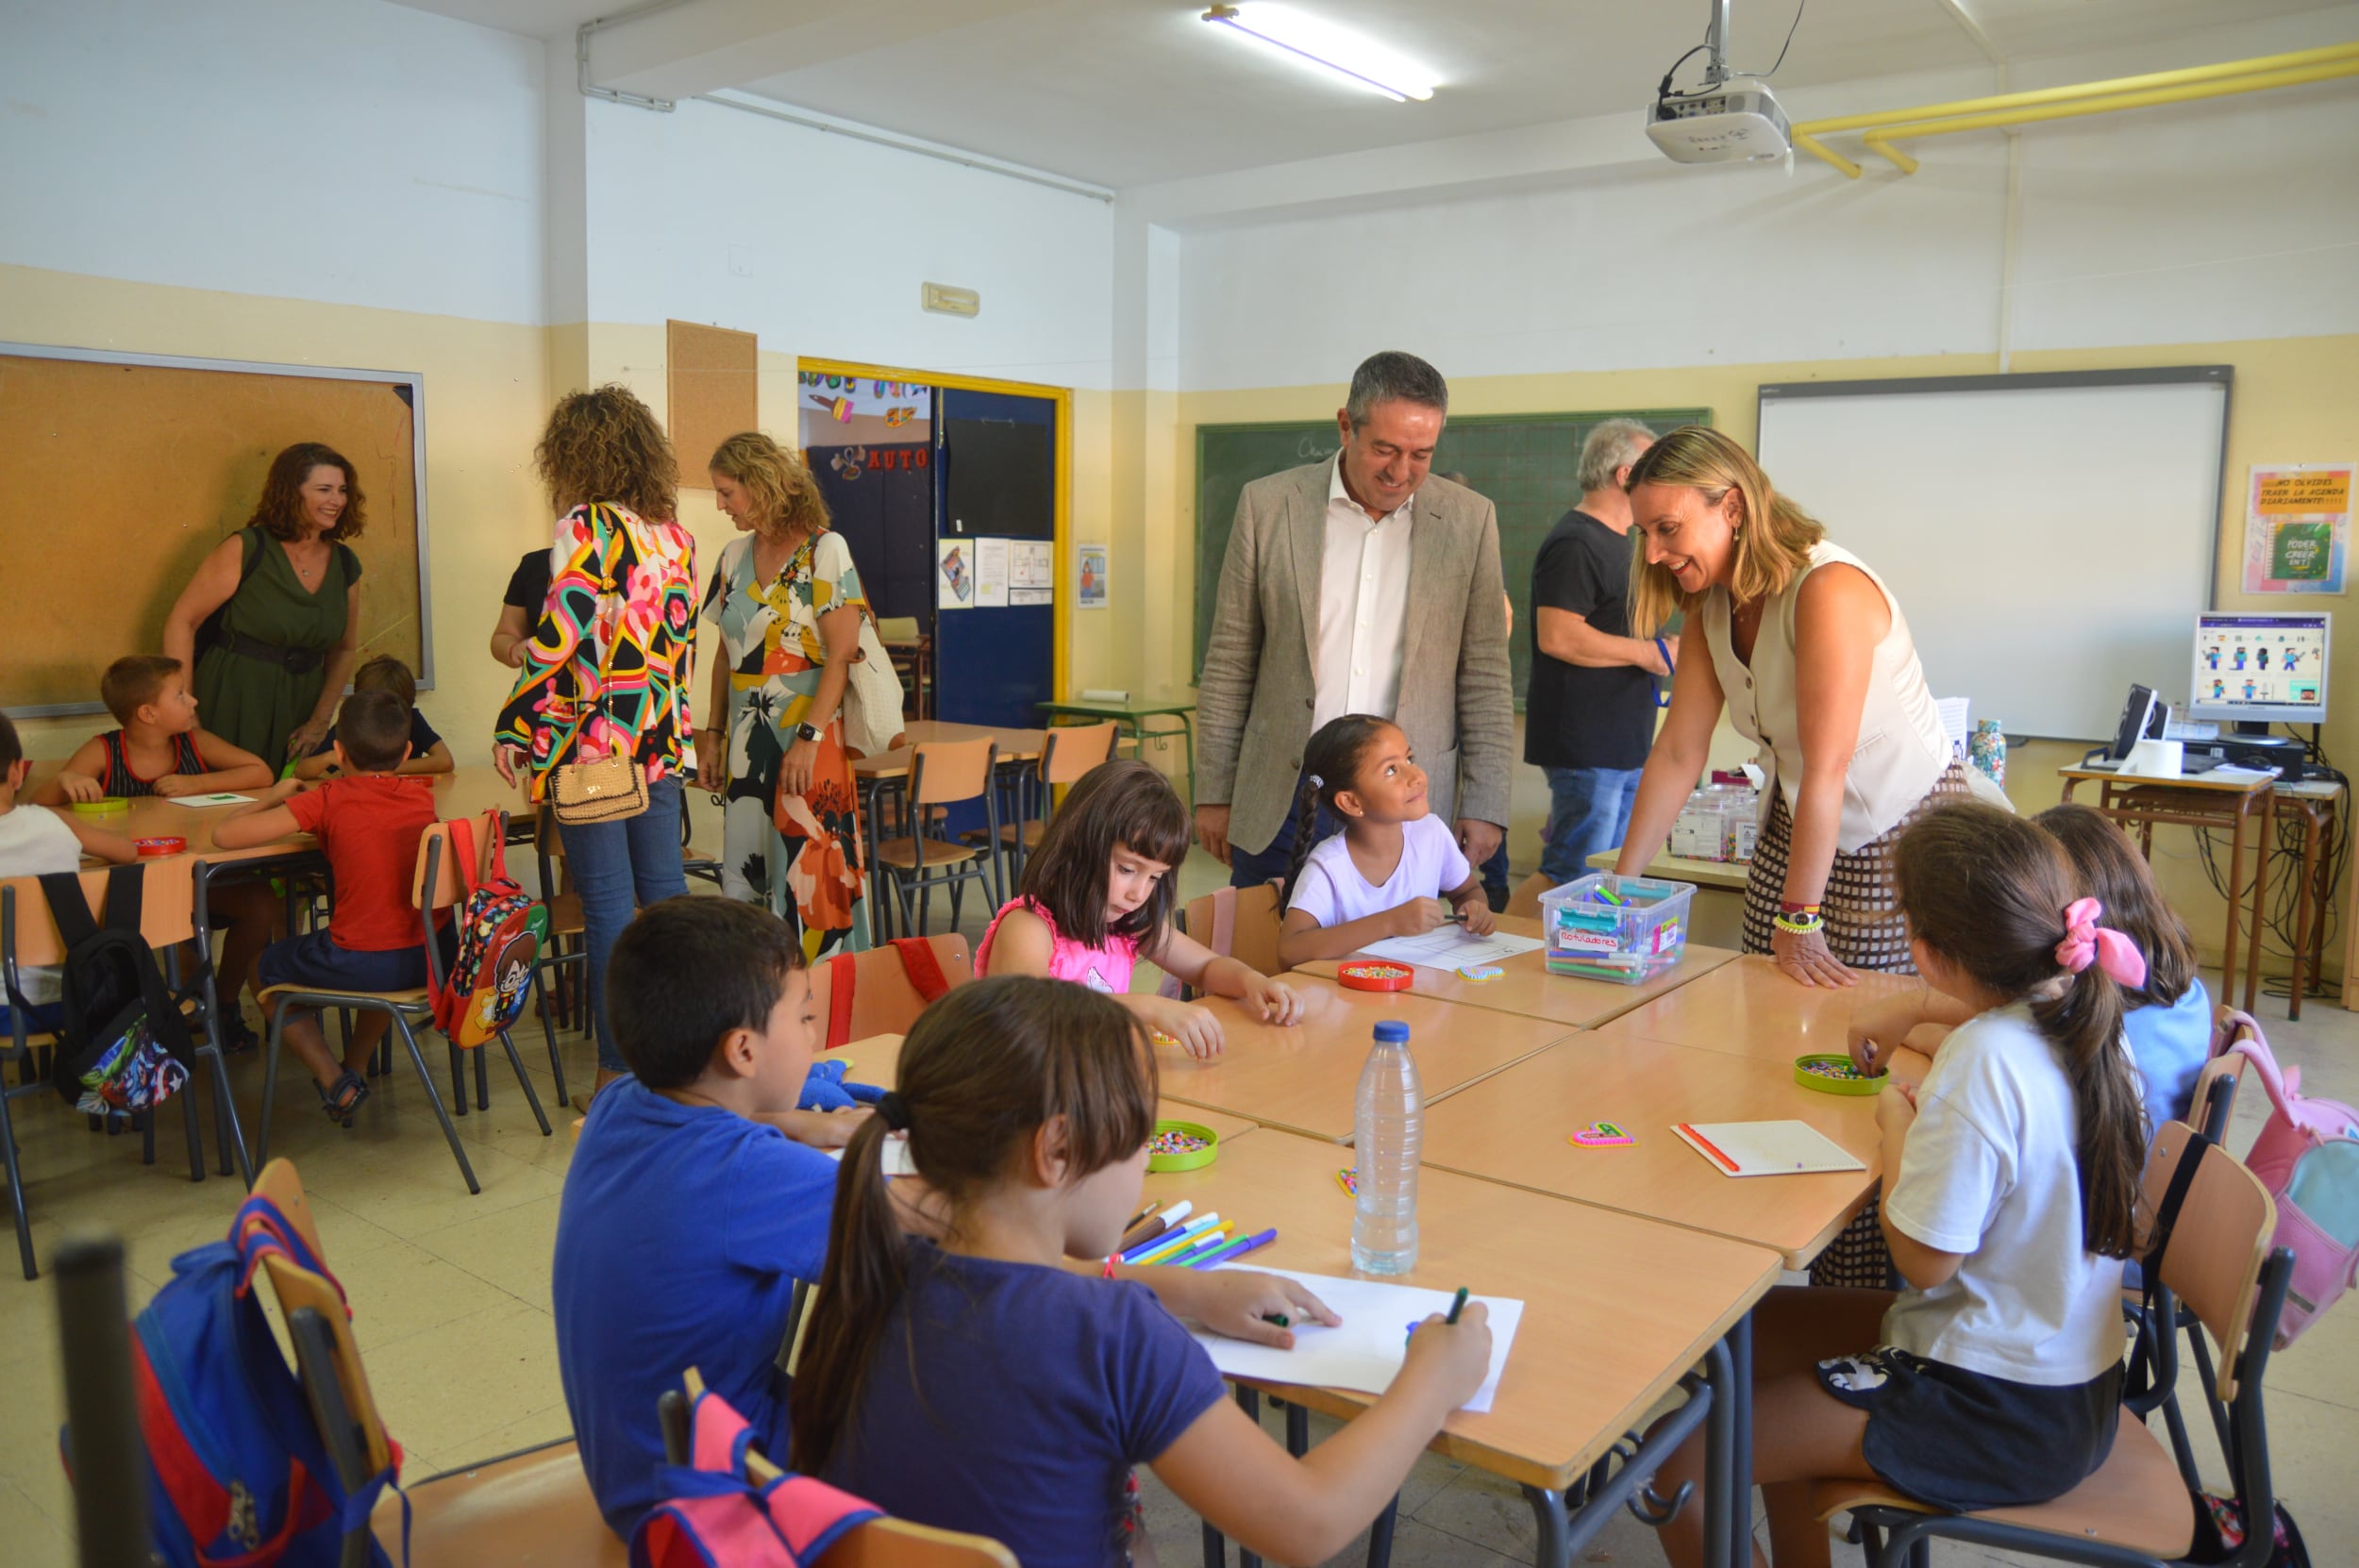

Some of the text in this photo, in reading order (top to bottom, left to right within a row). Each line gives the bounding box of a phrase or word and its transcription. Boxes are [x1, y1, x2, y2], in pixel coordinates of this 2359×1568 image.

[867, 448, 929, 470] AUTO
[2294, 478, 2333, 487] OLVIDES
[2308, 488, 2344, 496] AGENDA
[1561, 931, 1617, 947] Rotuladores
